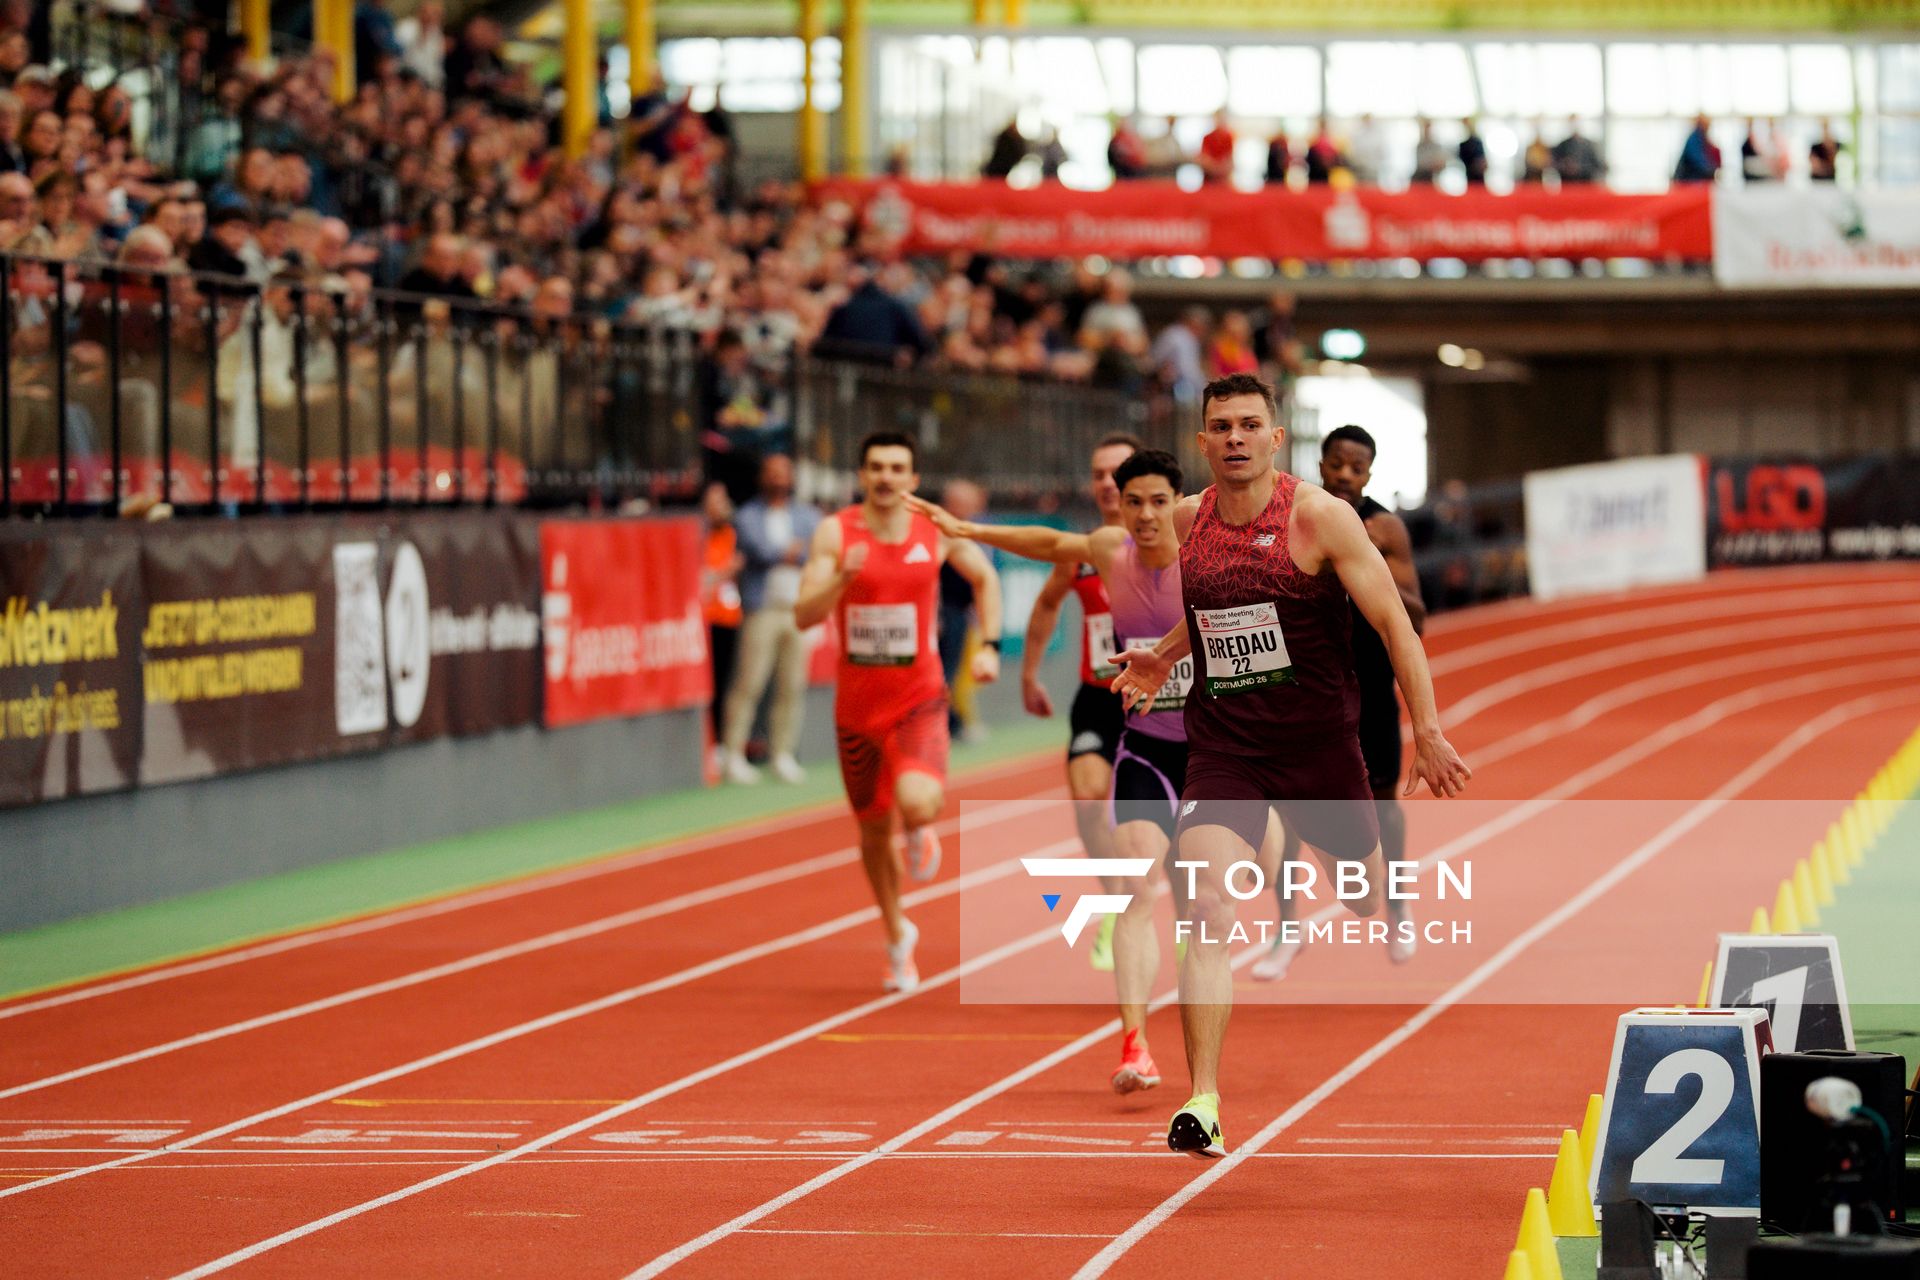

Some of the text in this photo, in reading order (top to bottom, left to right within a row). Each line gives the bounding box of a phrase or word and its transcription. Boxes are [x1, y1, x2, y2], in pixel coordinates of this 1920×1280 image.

[1227, 610, 1254, 619] Meeting
[1211, 620, 1240, 628] Dortmund
[1206, 630, 1277, 659] BREDAU
[1232, 657, 1252, 675] 22
[1214, 677, 1254, 689] DORTMUND
[1750, 965, 1808, 1054] 1
[1630, 1048, 1735, 1184] 2
